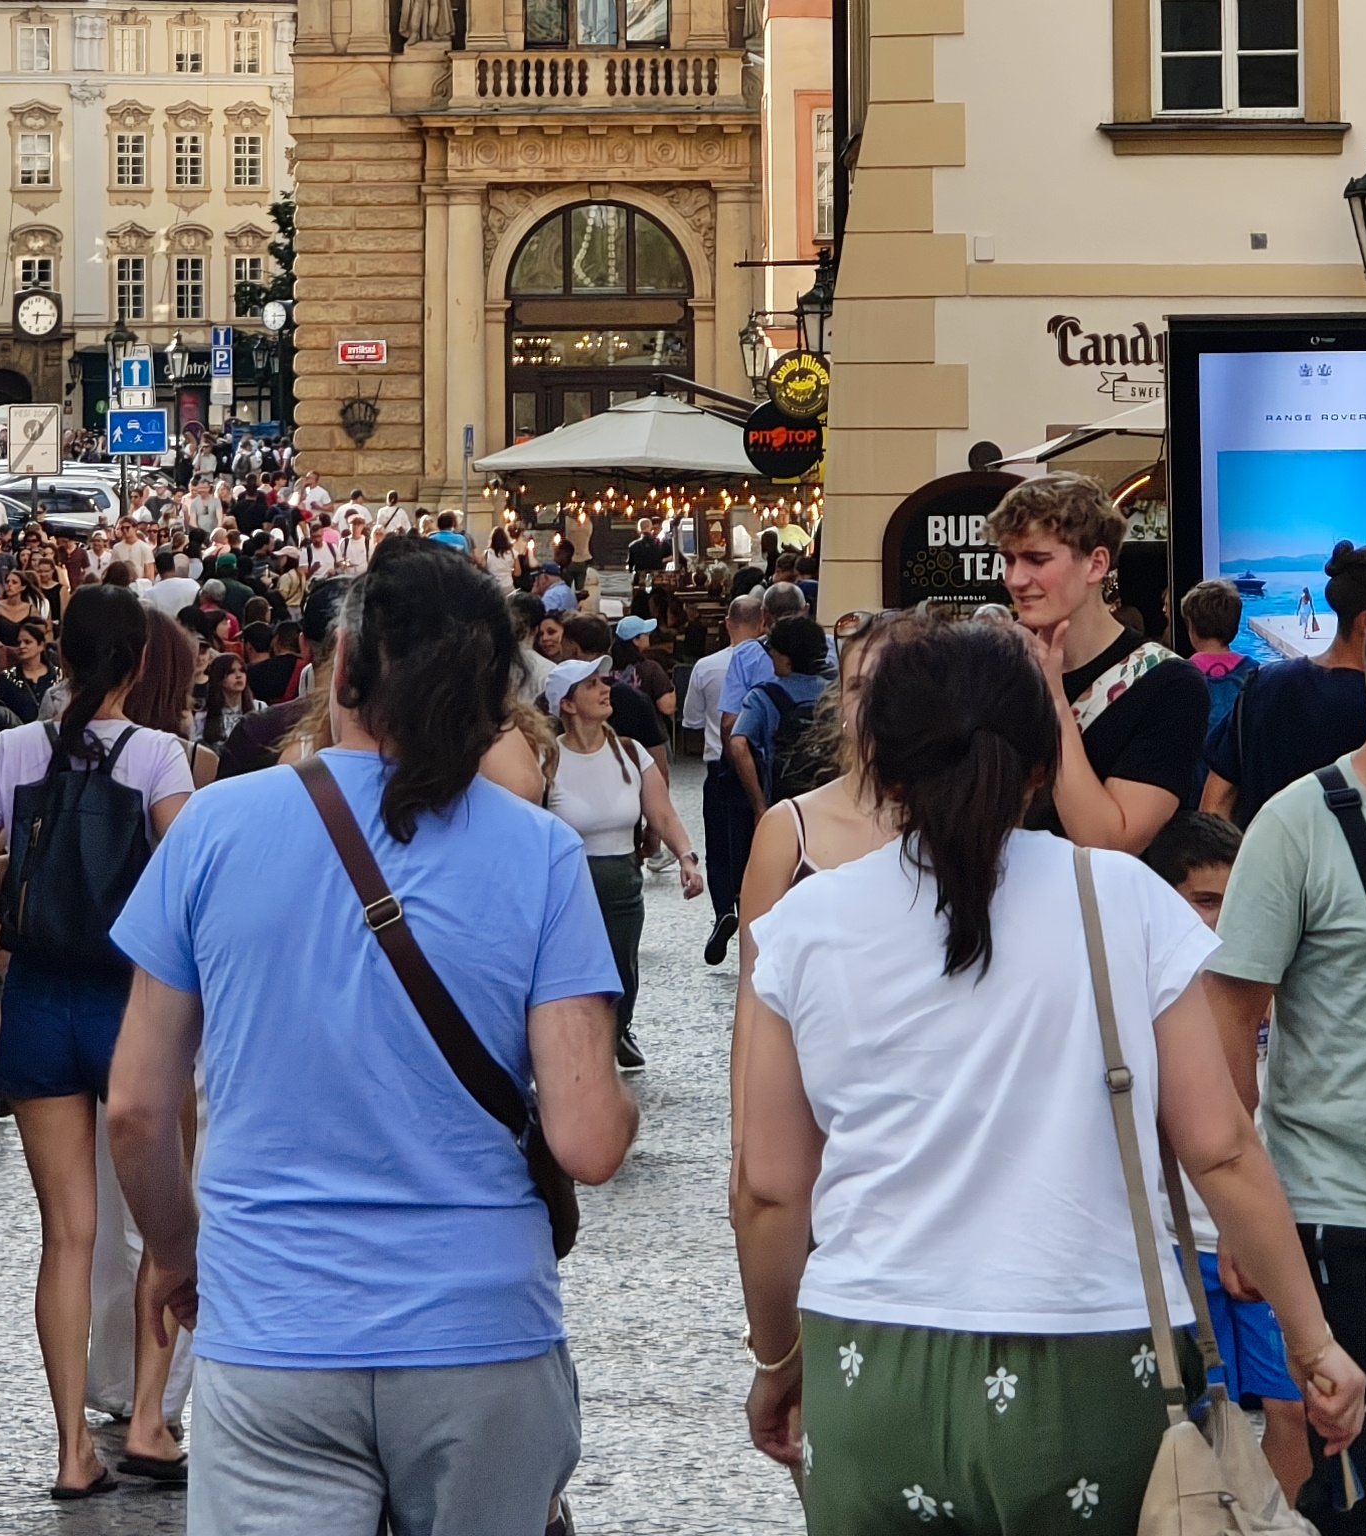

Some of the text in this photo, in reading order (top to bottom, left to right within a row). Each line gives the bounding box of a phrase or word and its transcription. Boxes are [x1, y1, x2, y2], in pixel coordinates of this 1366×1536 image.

[771, 354, 830, 385] Candy Miners
[1130, 386, 1163, 398] SWEE
[1321, 413, 1366, 421] ROVER
[928, 514, 1000, 547] BUB
[959, 552, 1008, 581] TEA
